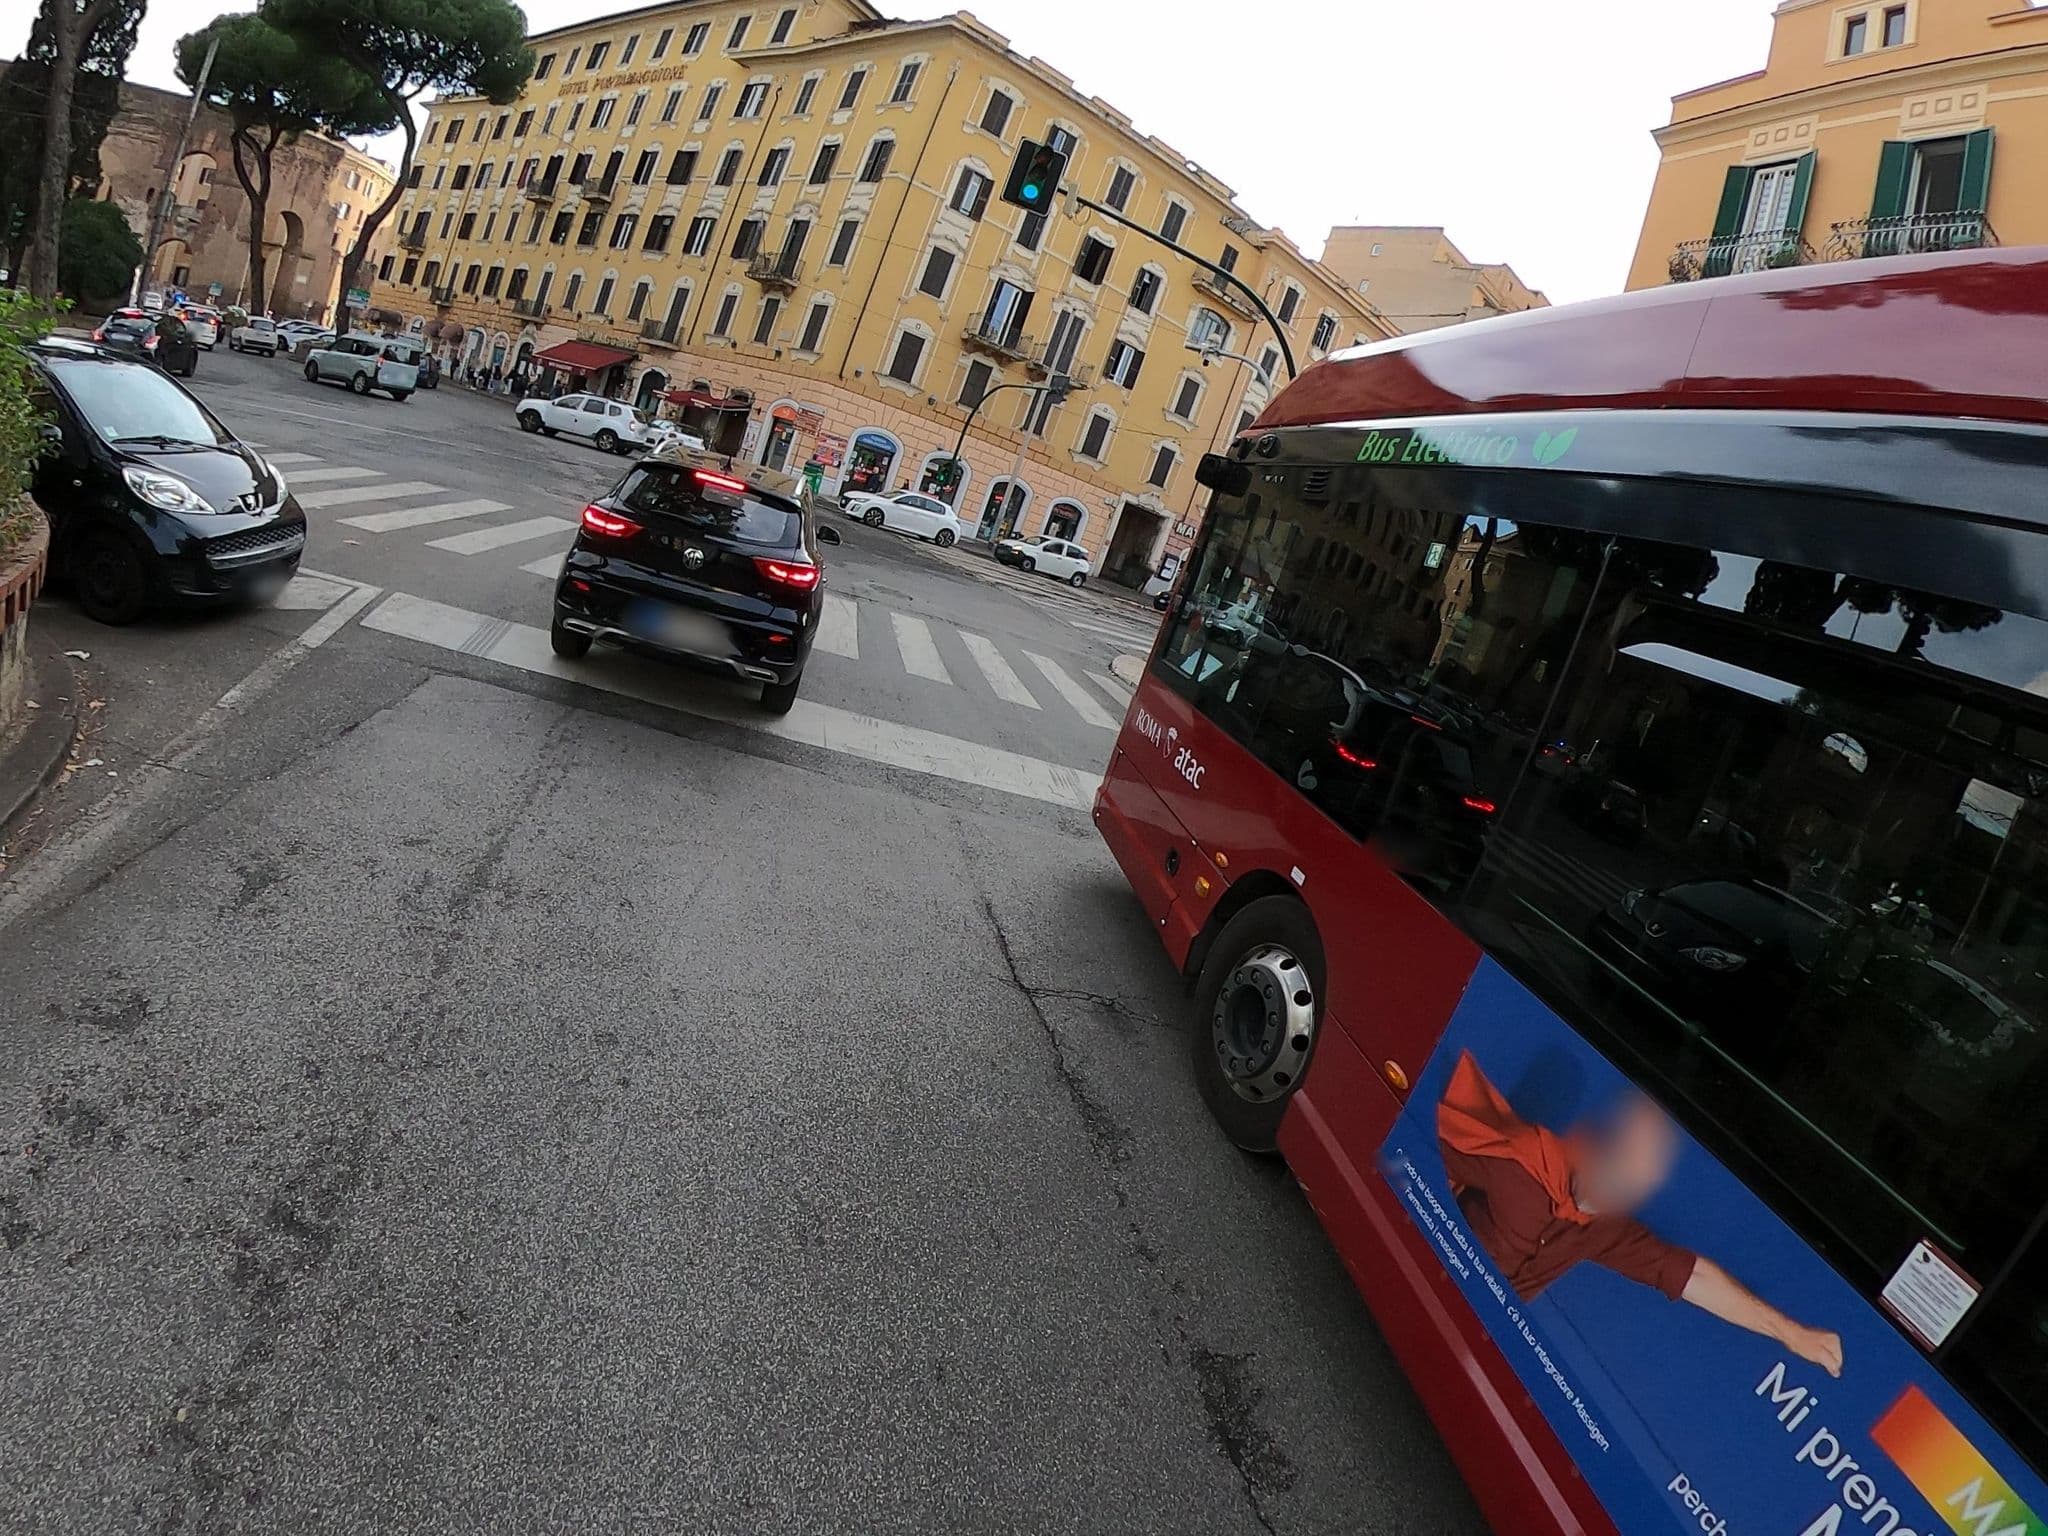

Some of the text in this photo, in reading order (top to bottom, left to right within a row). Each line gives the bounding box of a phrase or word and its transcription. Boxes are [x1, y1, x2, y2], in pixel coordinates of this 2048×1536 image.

[1357, 428, 1519, 464] Bus Elettrico
[1136, 708, 1163, 748] ROMA
[1174, 747, 1206, 790] atac
[1415, 1175, 1428, 1191] hai
[1424, 1187, 1448, 1222] bisogno
[1473, 1256, 1486, 1275] tua
[1522, 1326, 1536, 1346] tuo
[1534, 1341, 1574, 1401] integratore
[1755, 1361, 1818, 1433] Mi
[1795, 1426, 1934, 1536] pren
